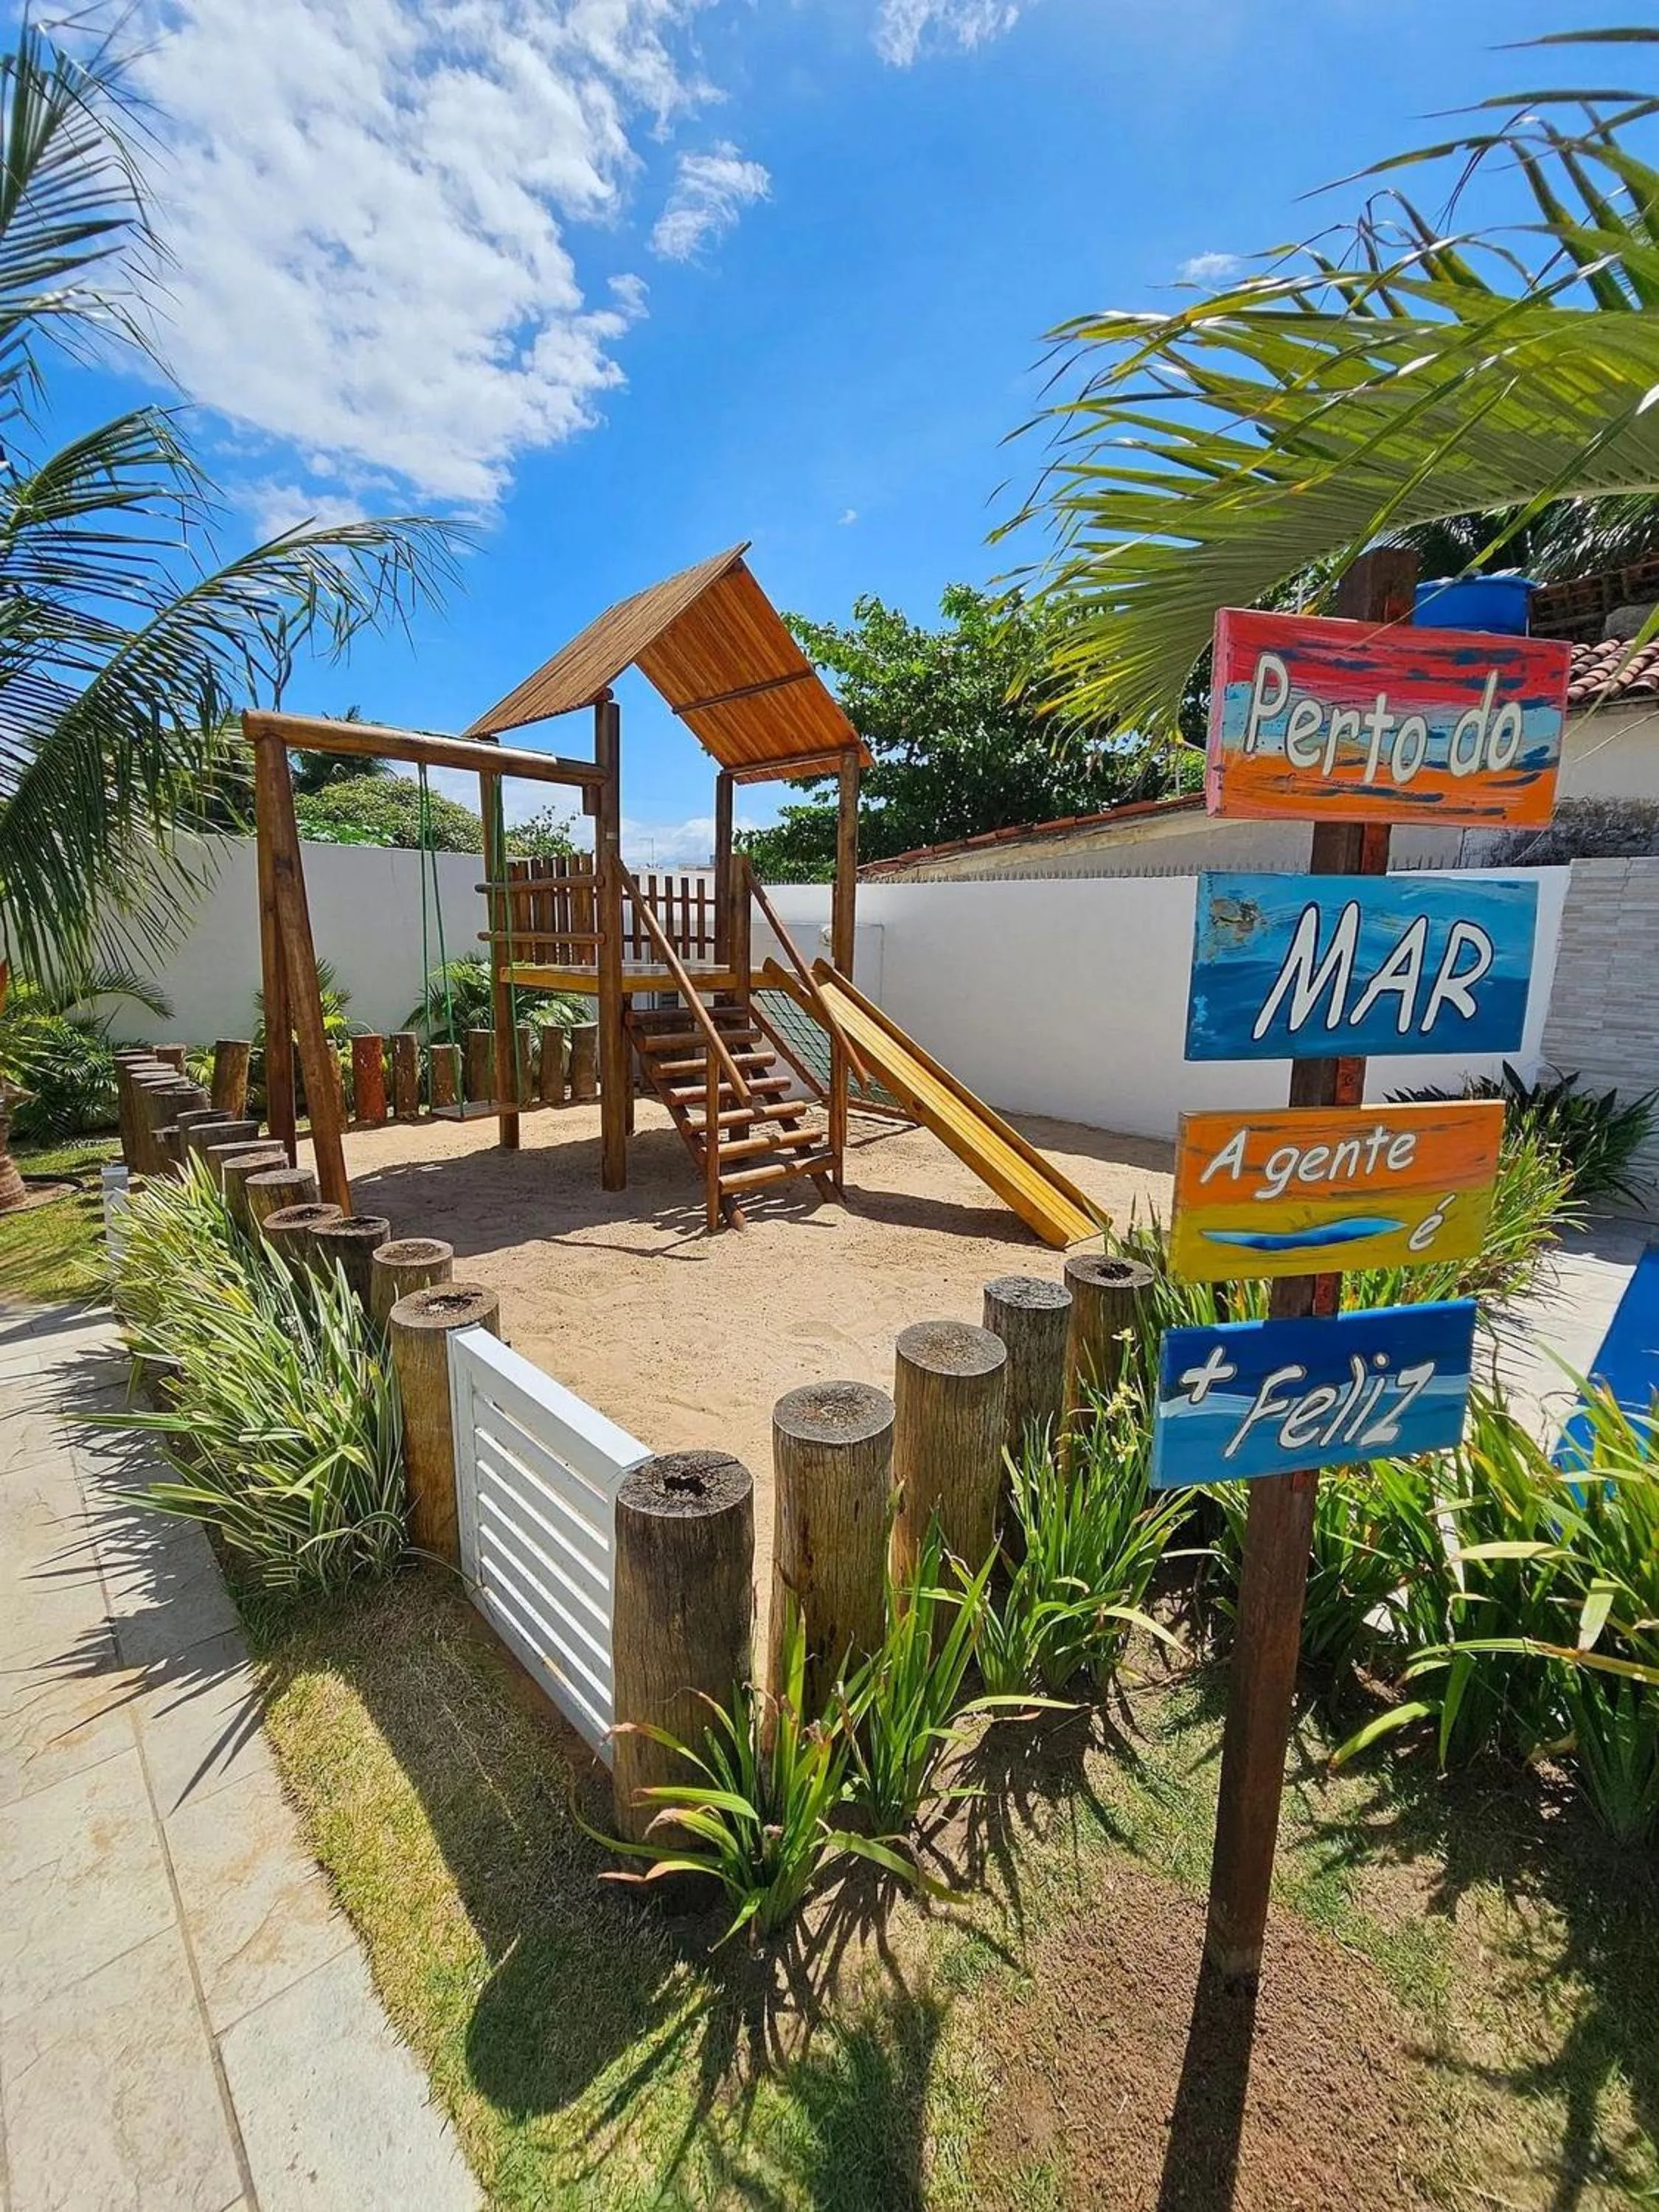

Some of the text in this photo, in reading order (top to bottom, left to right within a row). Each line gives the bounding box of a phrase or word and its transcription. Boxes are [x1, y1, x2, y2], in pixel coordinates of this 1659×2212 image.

[1244, 652, 1523, 785] Perto do
[1251, 900, 1495, 1041] MAR
[1199, 1125, 1417, 1200] A gente
[1408, 1192, 1457, 1252] é
[1223, 1352, 1436, 1458] Feliz
